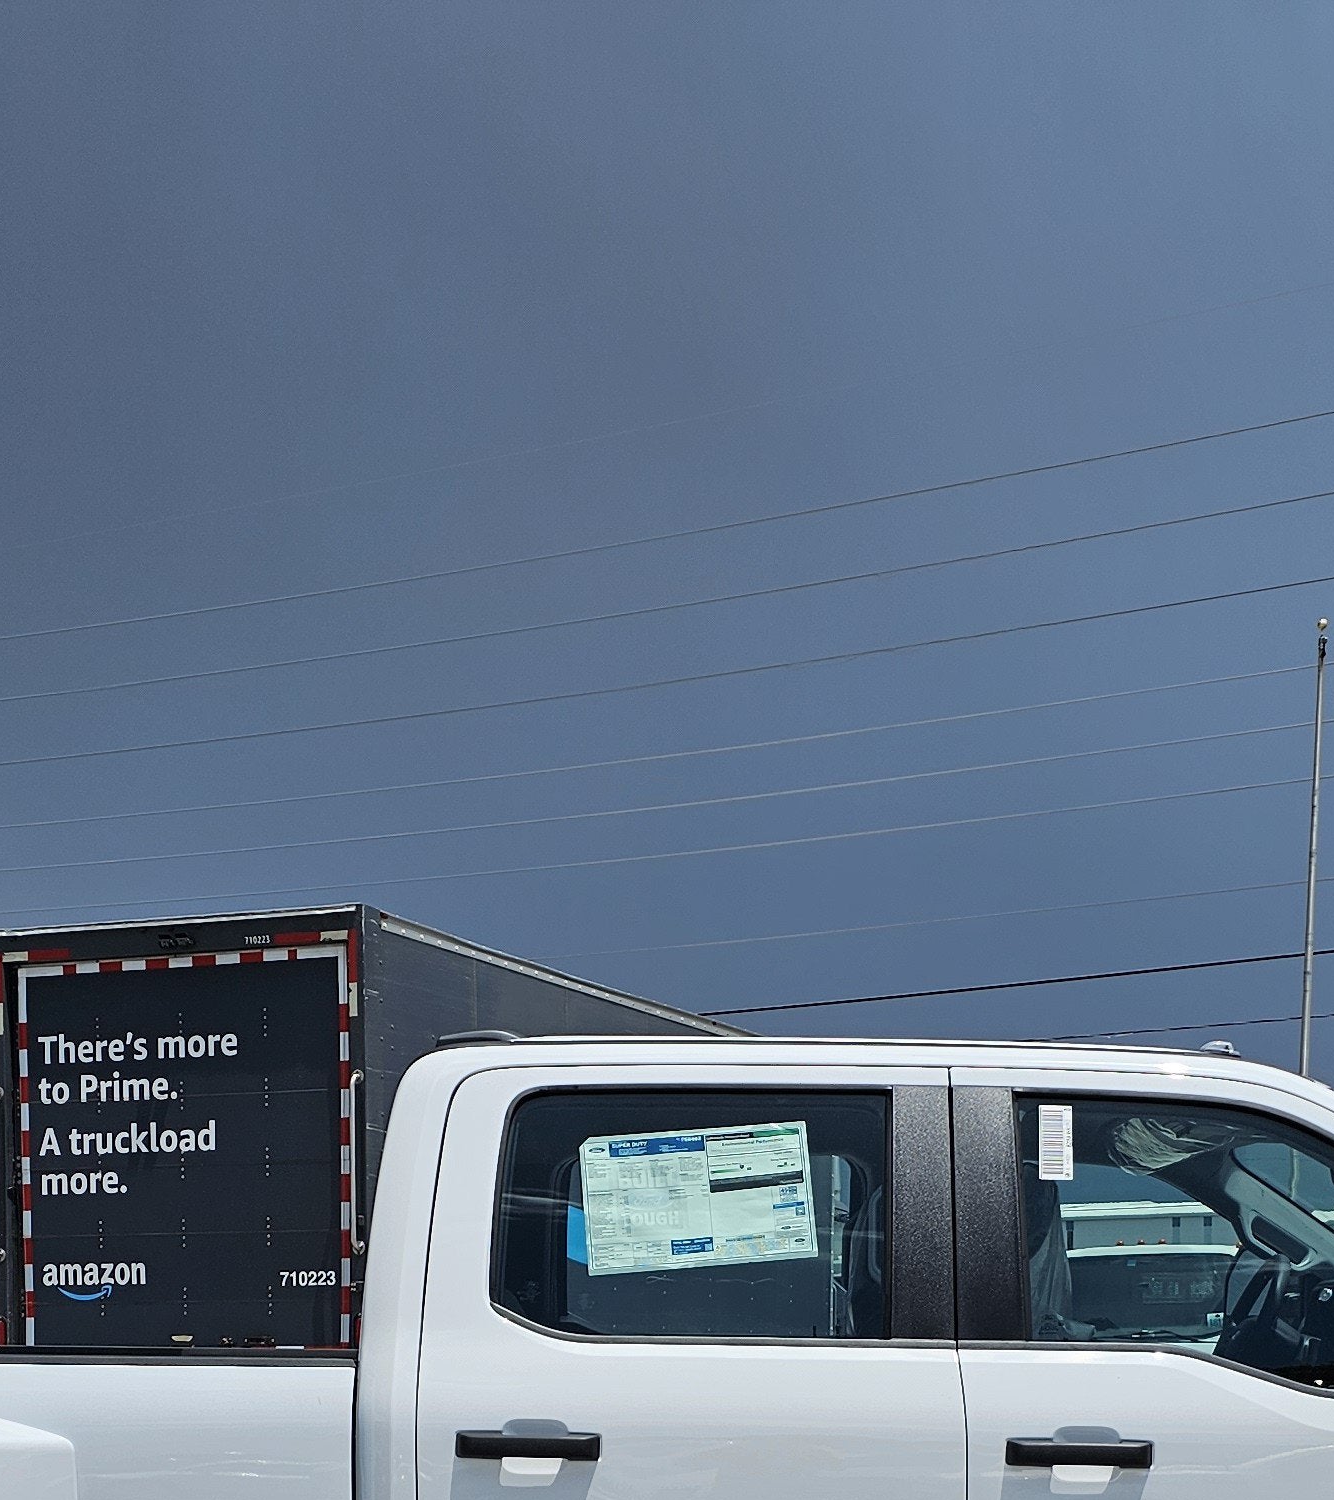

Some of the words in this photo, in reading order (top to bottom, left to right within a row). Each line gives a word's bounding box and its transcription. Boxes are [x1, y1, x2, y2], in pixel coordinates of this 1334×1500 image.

[244, 934, 271, 945] 710223
[37, 1032, 148, 1065] There's
[157, 1033, 238, 1060] more
[38, 1077, 70, 1105] to
[80, 1071, 178, 1103] Prime.
[38, 1127, 62, 1156] A
[68, 1119, 216, 1156] truckload
[41, 1171, 128, 1196] more.
[42, 1262, 146, 1287] amazon
[279, 1270, 337, 1287] 710223
